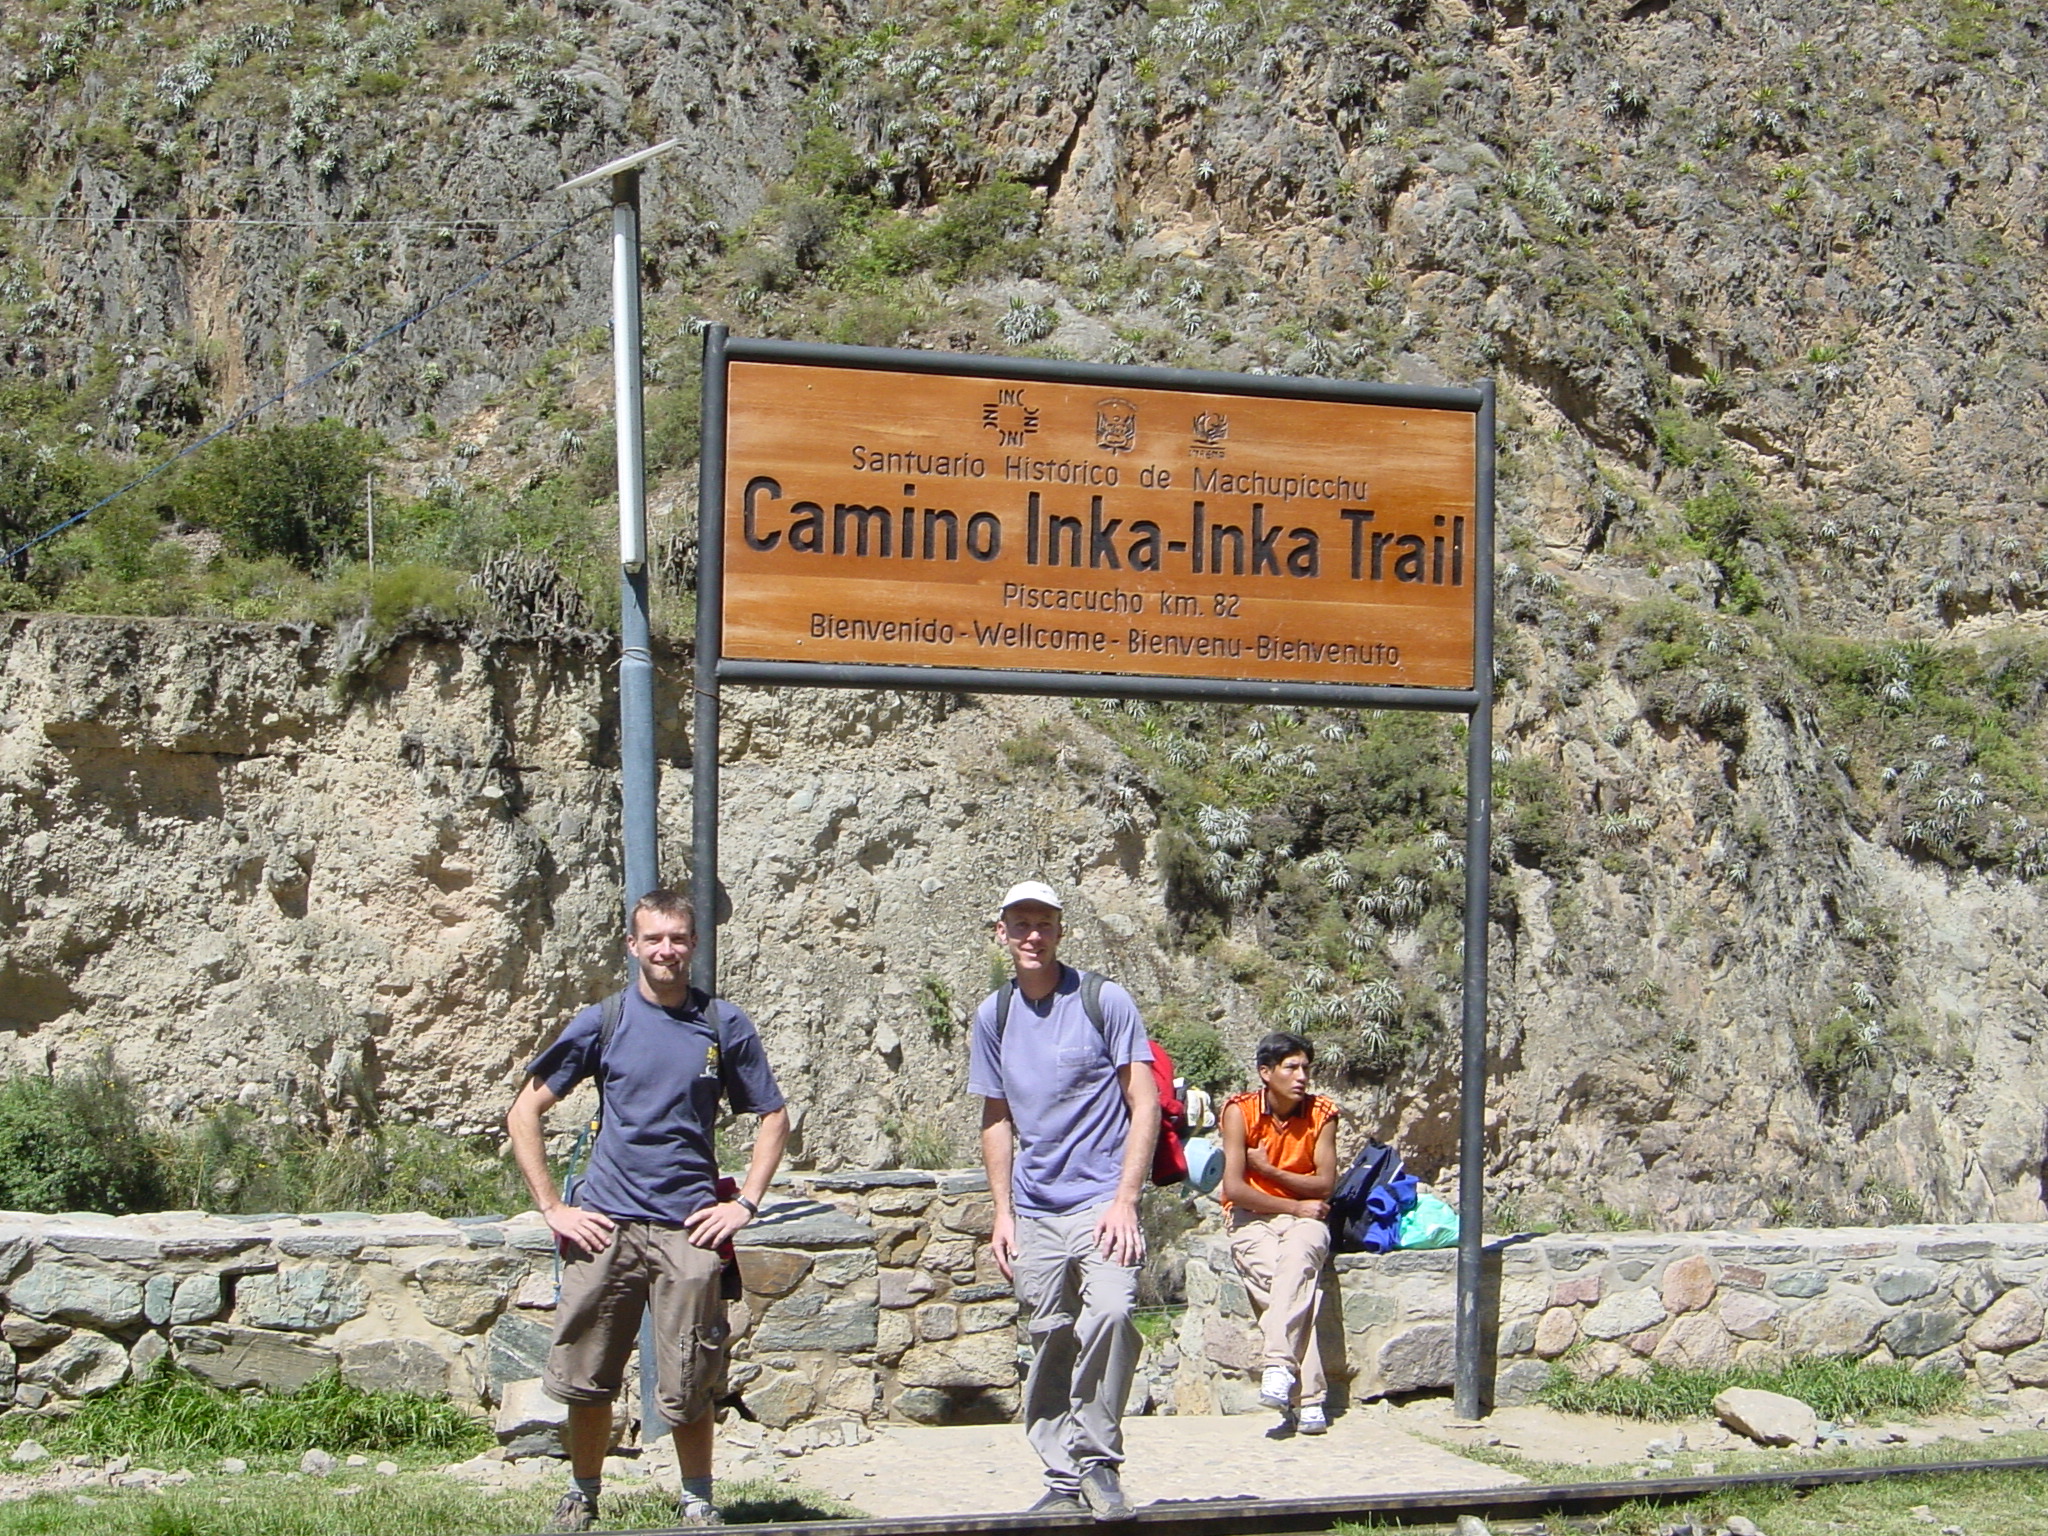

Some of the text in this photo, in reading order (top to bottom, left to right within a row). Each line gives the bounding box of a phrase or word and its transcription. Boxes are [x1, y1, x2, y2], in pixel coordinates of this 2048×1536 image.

[998, 389, 1024, 406] INC
[852, 445, 1368, 501] Santuario Histórico de Machupicchu
[743, 475, 1001, 562] Camino
[1340, 508, 1465, 586] Trail
[1003, 582, 1241, 618] Piscacucho km. 82
[810, 613, 954, 643] Bienvenido
[973, 620, 1106, 651] Wellcome
